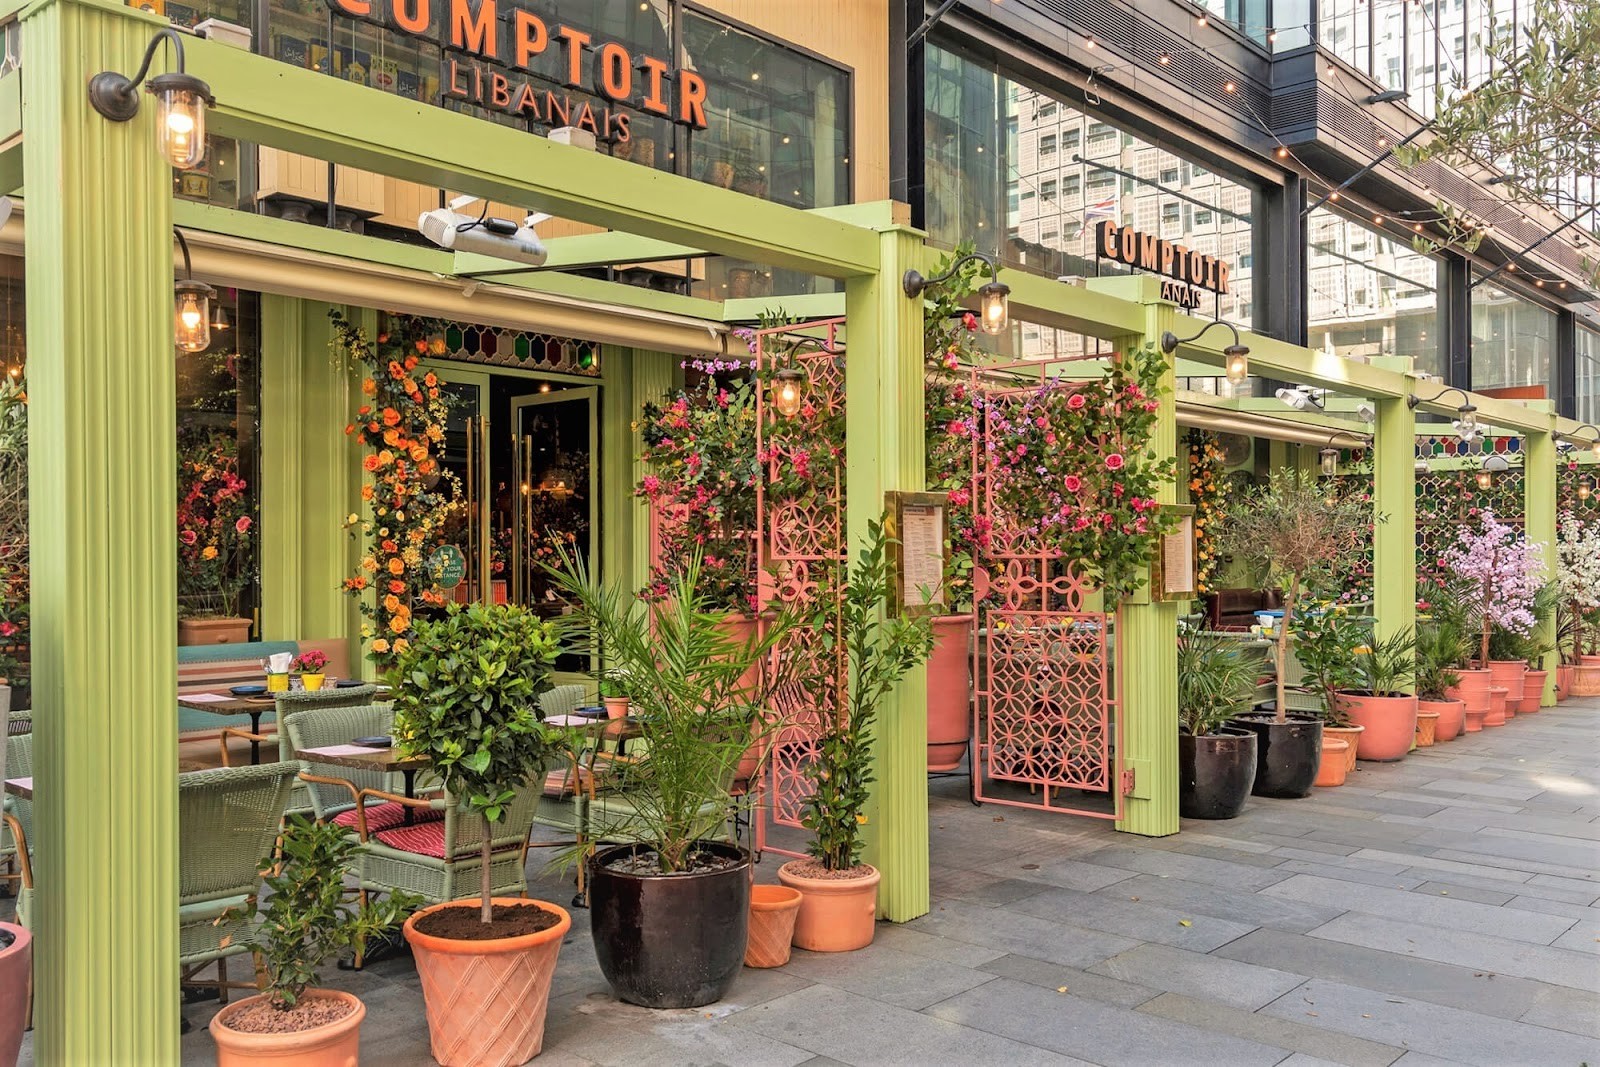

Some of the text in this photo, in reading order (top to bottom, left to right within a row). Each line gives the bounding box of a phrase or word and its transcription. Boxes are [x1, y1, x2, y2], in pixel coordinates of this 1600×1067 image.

[337, 0, 708, 129] OMPTOIR
[450, 58, 632, 143] LIBANAIS
[1104, 220, 1230, 294] COMPTOIR
[1162, 281, 1201, 308] ANAIS
